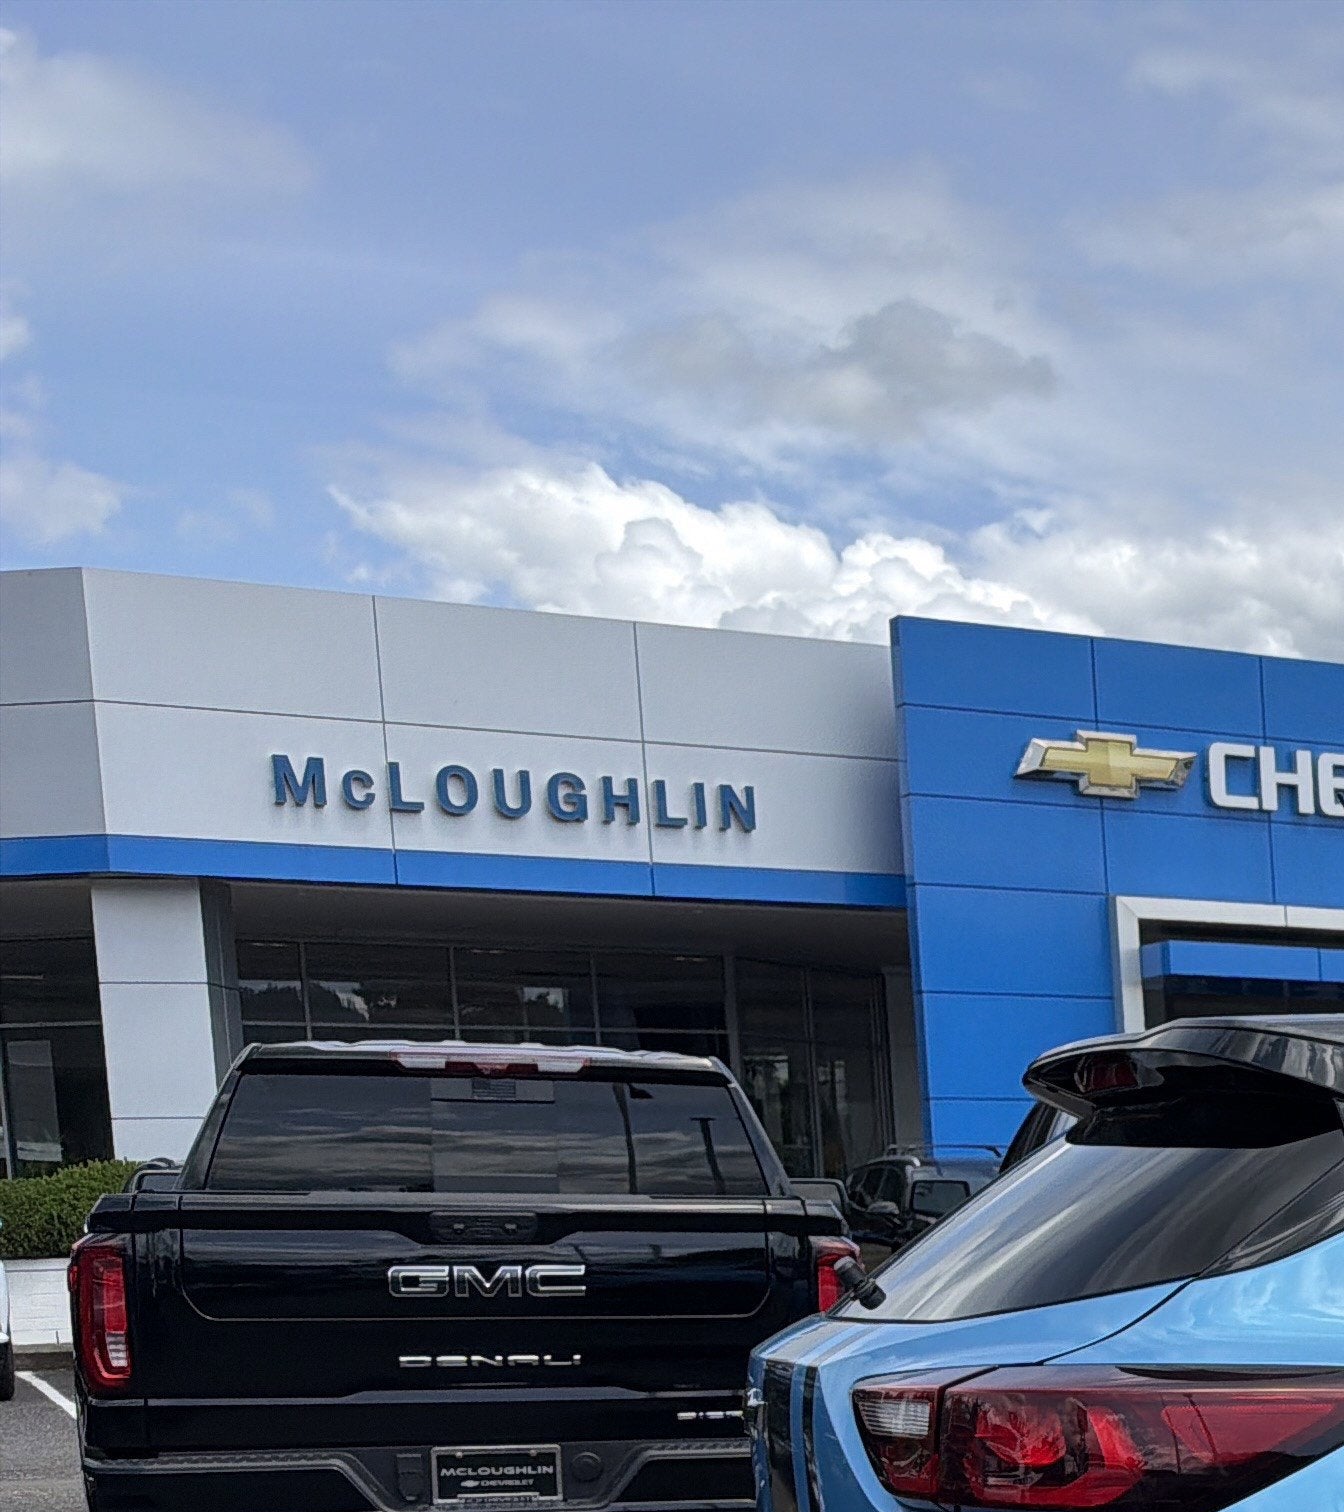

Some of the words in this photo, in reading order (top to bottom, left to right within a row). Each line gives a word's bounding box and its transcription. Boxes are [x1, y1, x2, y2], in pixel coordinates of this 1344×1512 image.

[387, 1264, 587, 1298] GMC
[398, 1353, 582, 1367] DENALI
[440, 1465, 554, 1476] MCLOUGHLIN
[480, 1478, 534, 1487] CHEVROLET
